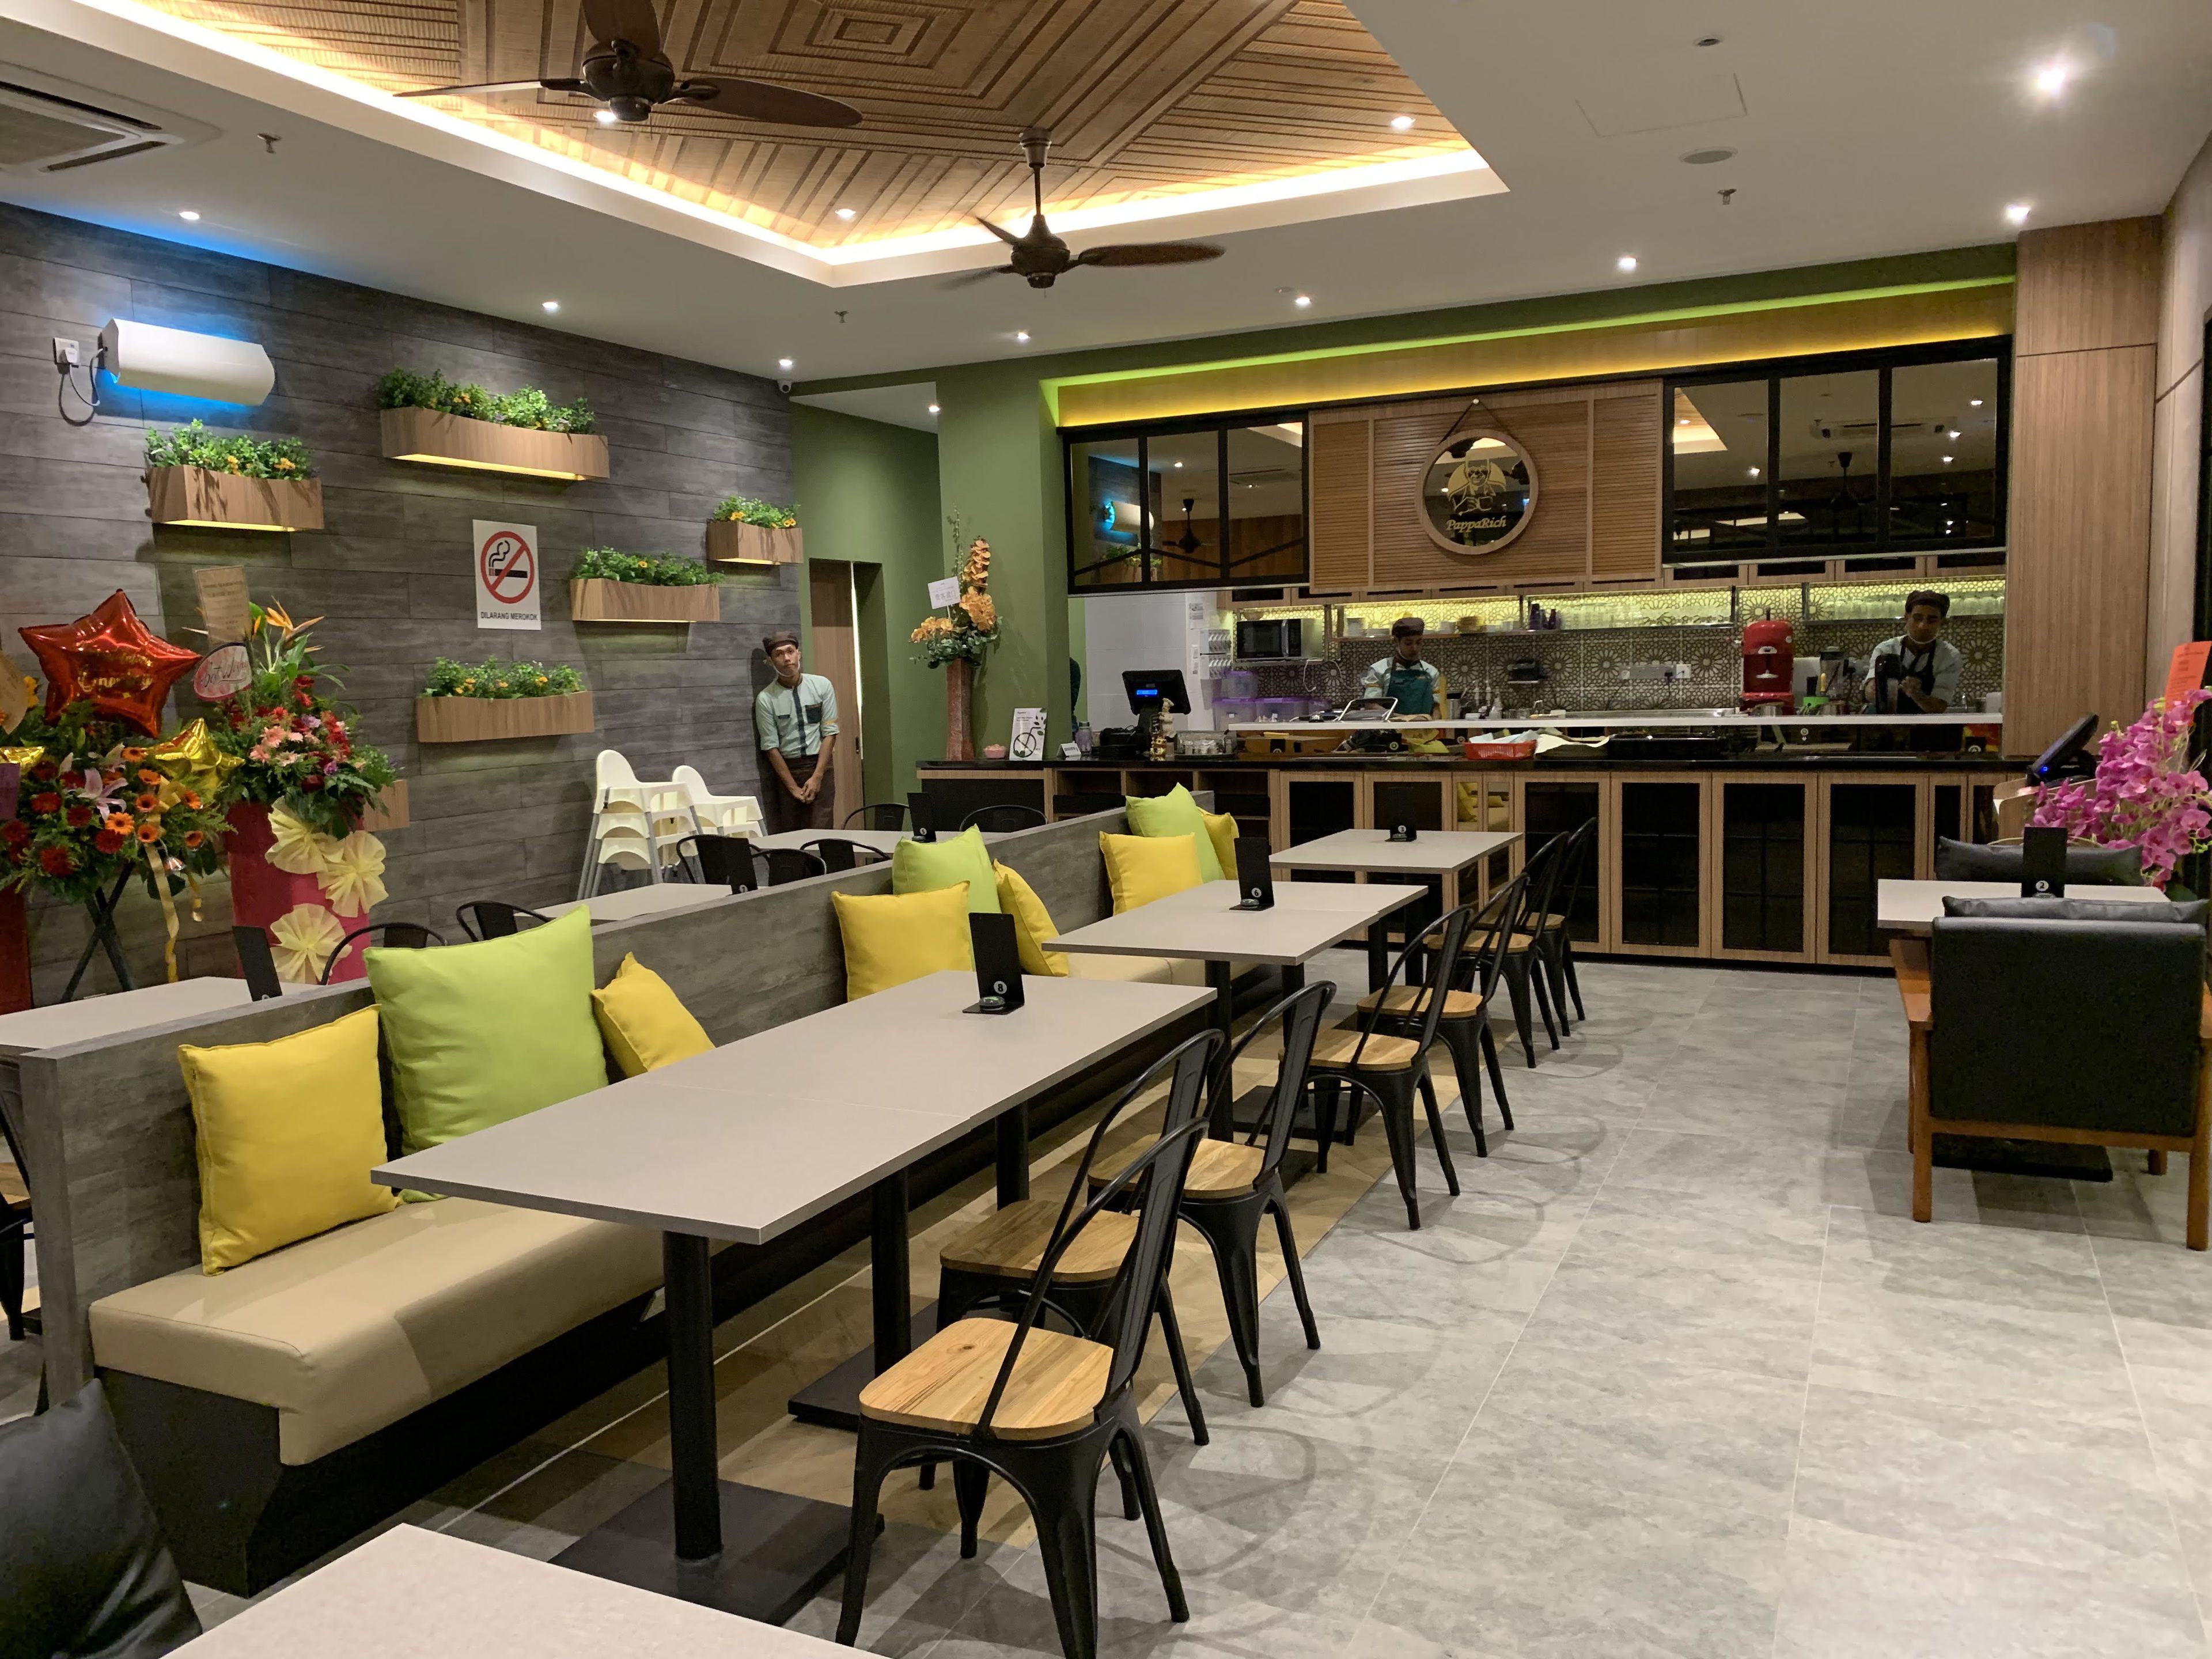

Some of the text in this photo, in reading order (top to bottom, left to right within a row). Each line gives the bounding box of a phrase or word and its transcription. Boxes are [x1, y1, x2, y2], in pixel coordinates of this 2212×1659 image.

[1446, 515, 1507, 533] PappaRich
[480, 611, 538, 621] DILARANG MEROKOK
[997, 983, 1003, 992] 8
